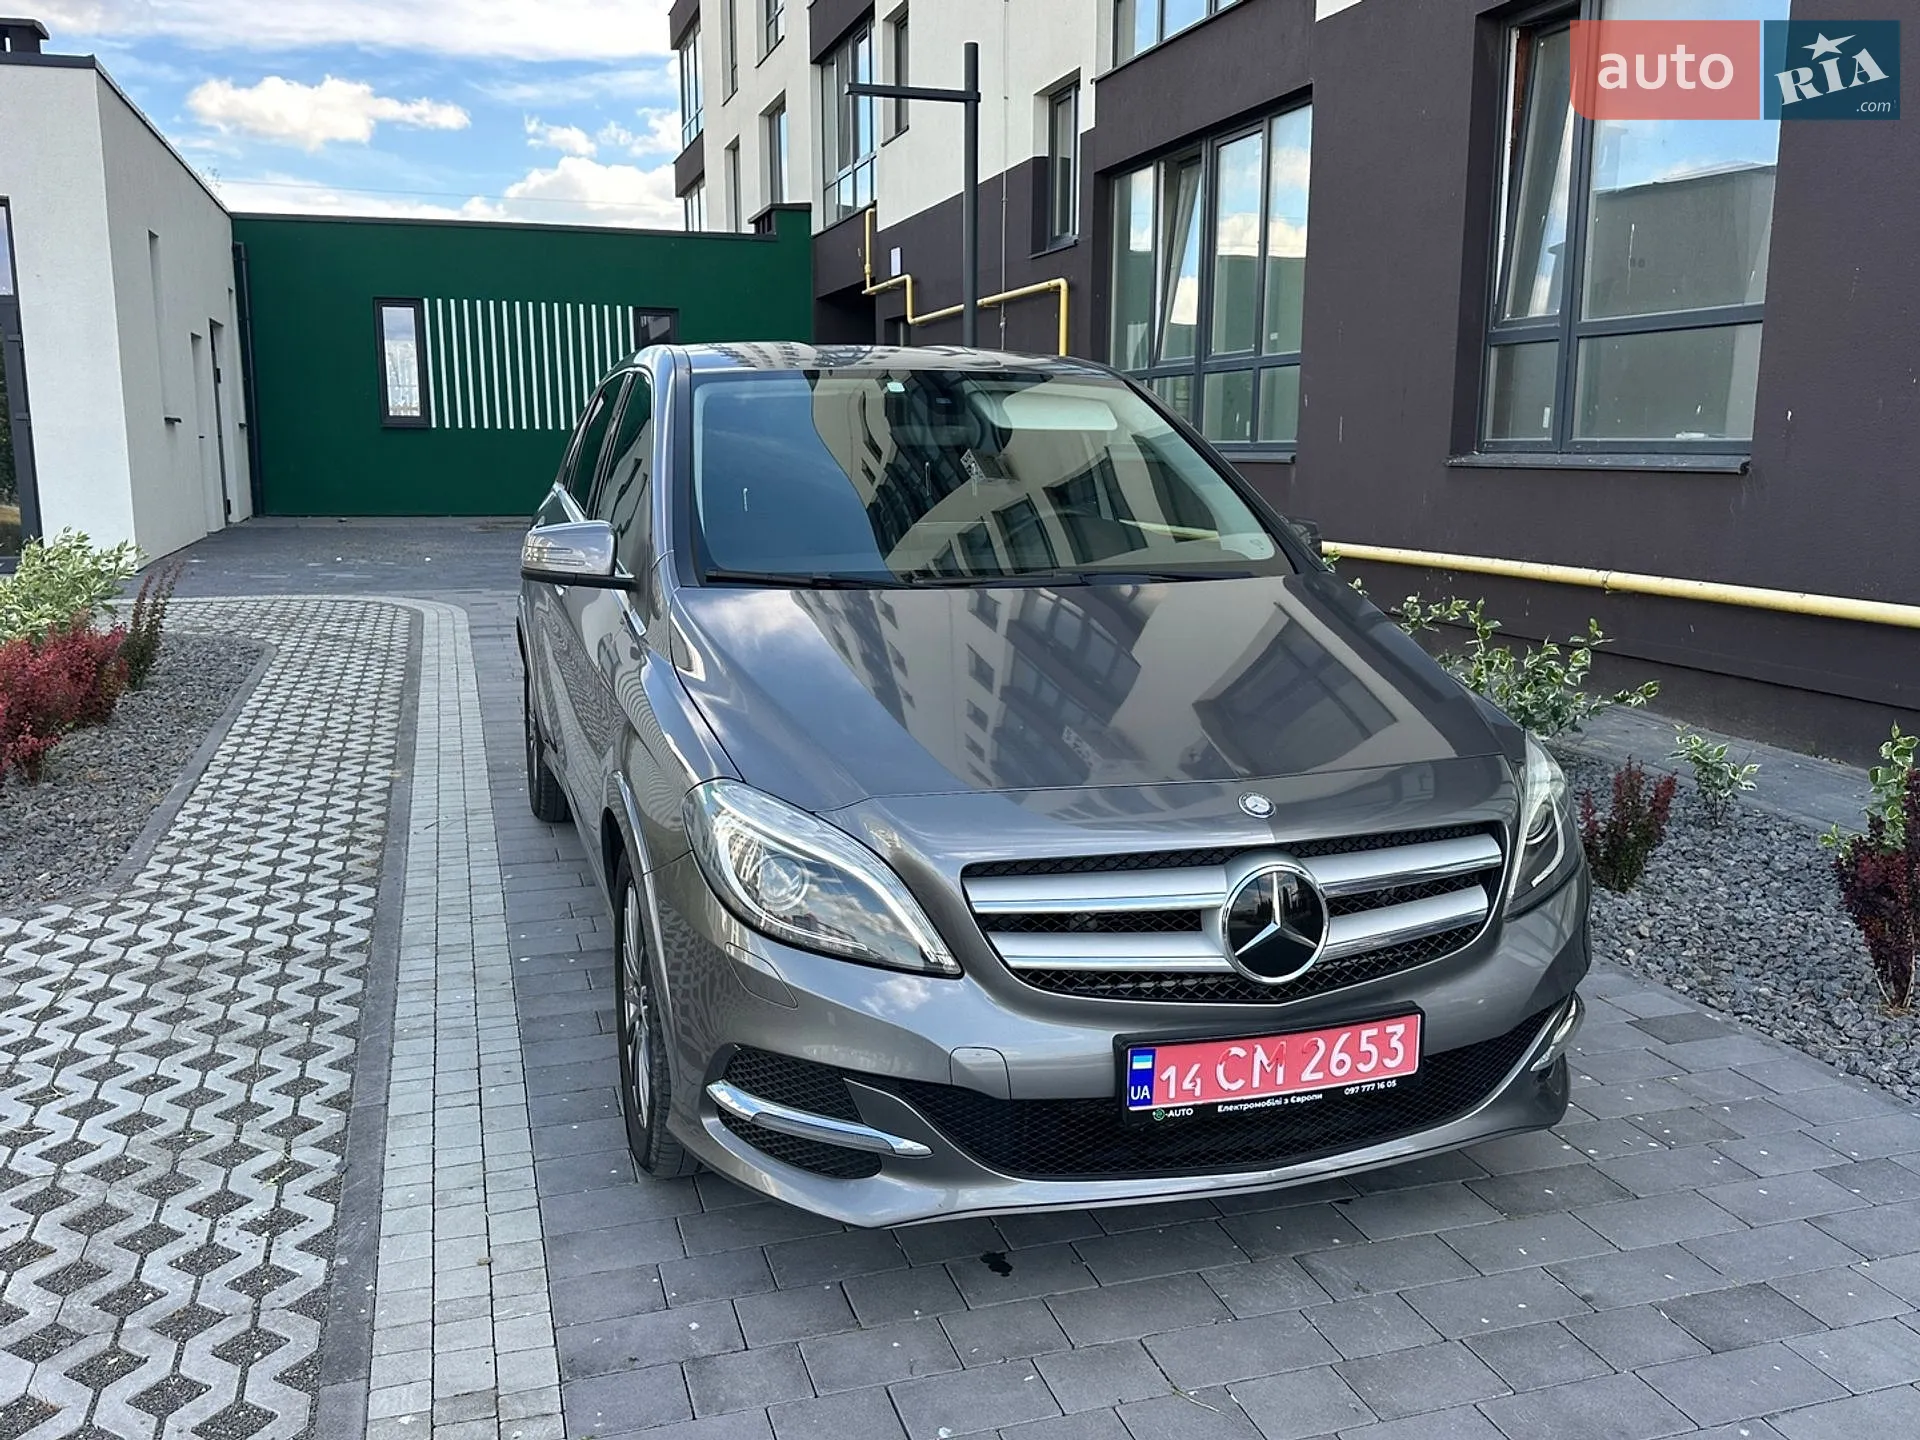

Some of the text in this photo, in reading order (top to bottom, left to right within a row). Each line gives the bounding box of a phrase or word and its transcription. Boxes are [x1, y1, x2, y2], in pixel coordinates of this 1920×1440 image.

[1160, 1063, 1202, 1099] 14
[1301, 1023, 1405, 1082] 2653
[1130, 1085, 1151, 1100] UA
